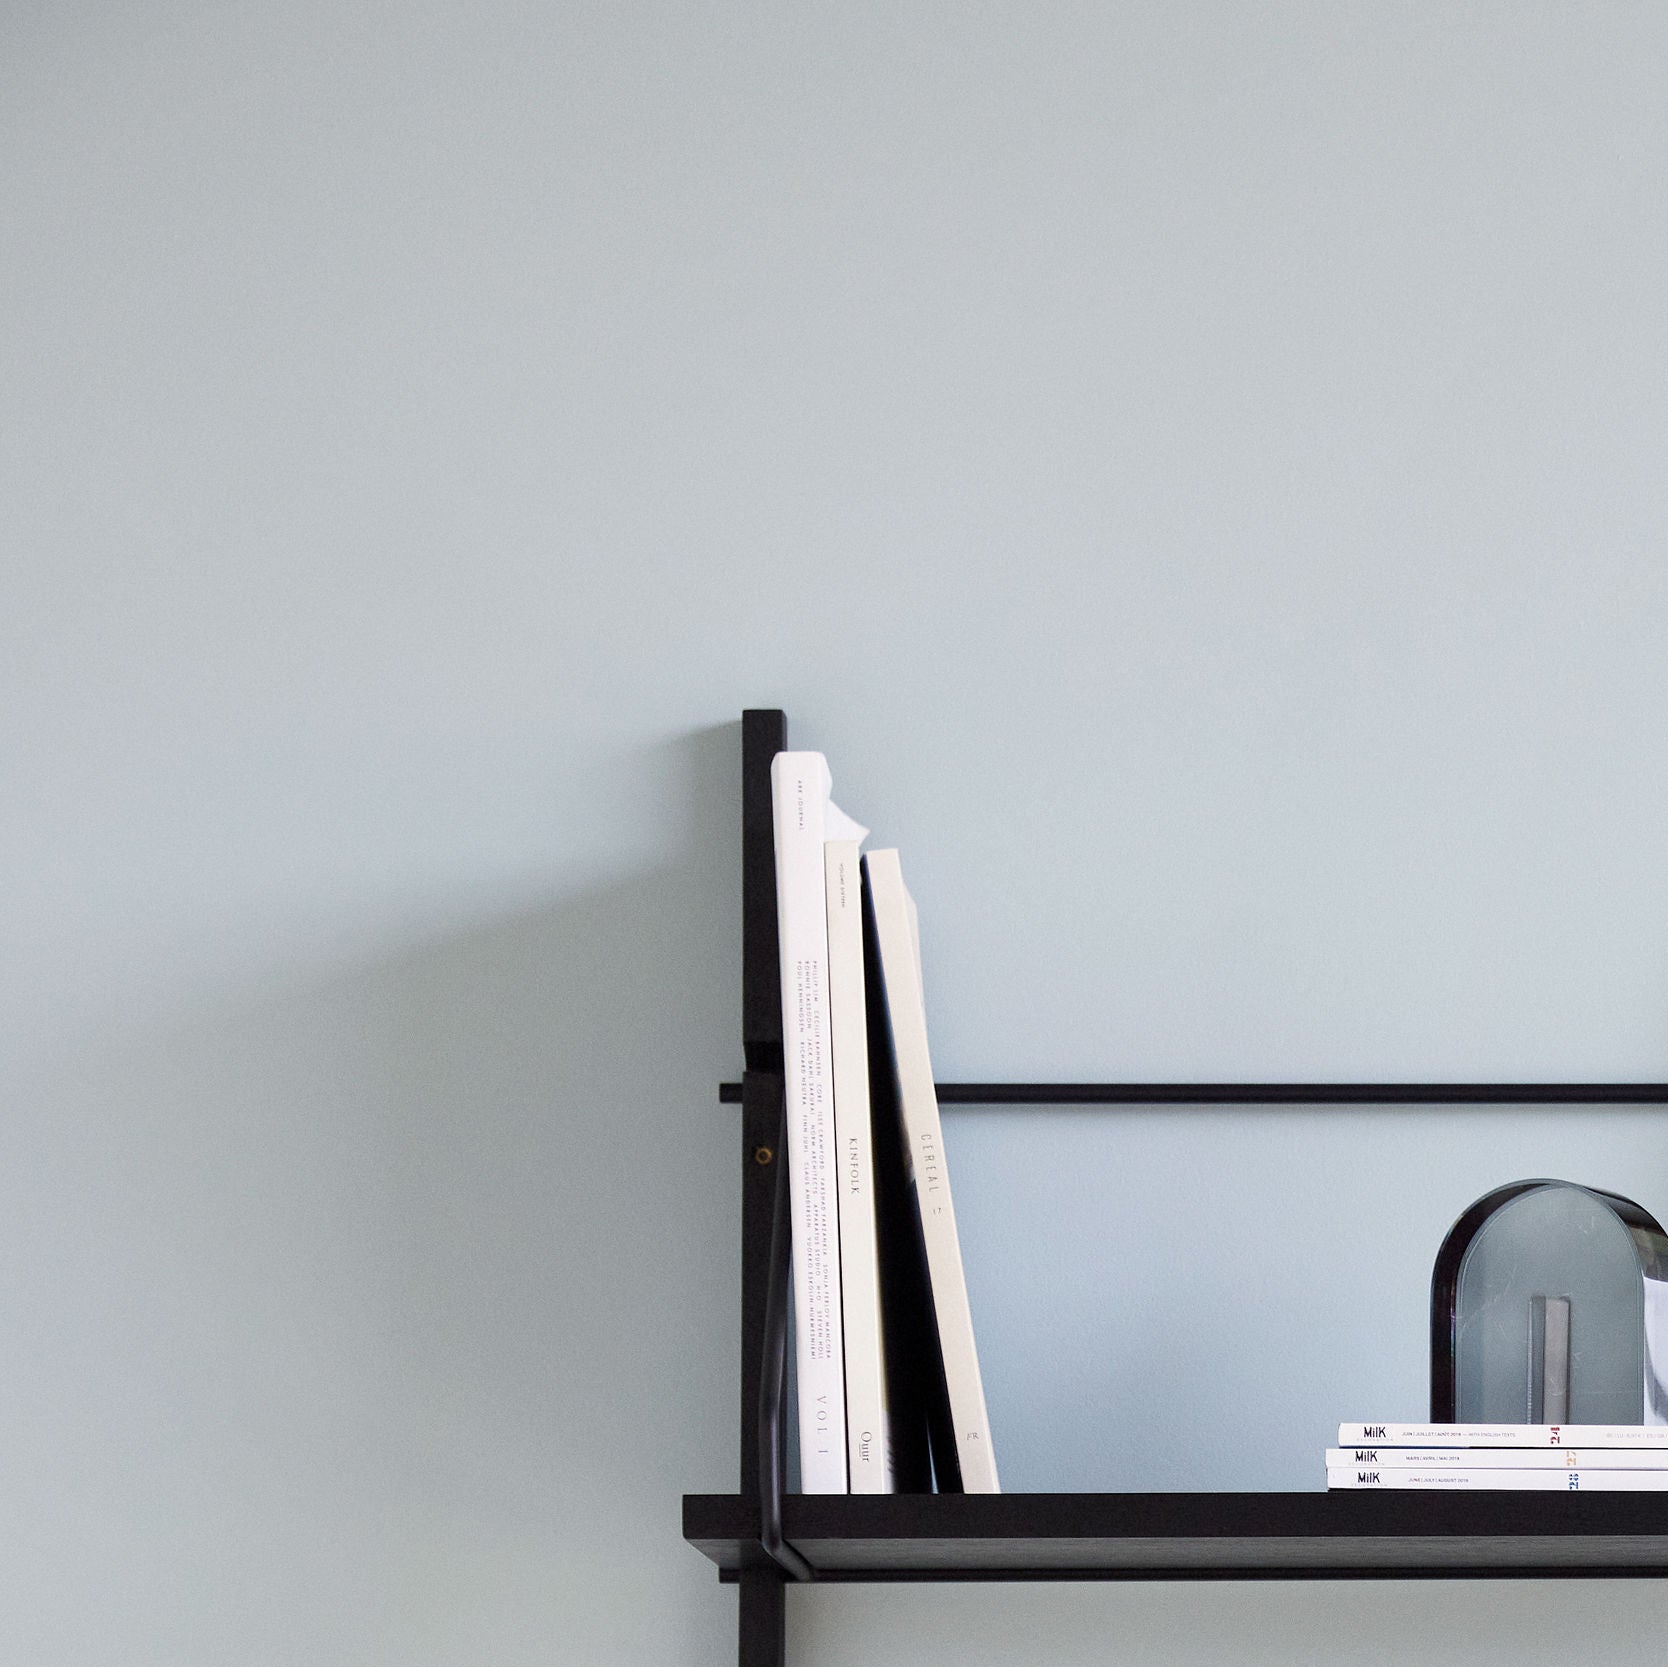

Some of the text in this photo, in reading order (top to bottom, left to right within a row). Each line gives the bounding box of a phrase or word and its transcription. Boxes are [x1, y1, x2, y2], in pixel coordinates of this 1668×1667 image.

[817, 1129, 825, 1170] CRAWFORD
[848, 1138, 861, 1195] KINFOLK
[920, 1134, 940, 1193] CEREAL
[810, 1150, 818, 1194] ARCHITECTS
[812, 1204, 820, 1245] APPARATUS
[813, 1249, 821, 1276] STUDIO
[815, 1311, 823, 1338] STEVEN
[859, 1431, 873, 1463] Ouur
[1550, 1427, 1561, 1445] 24
[1568, 1472, 1580, 1491] 28
